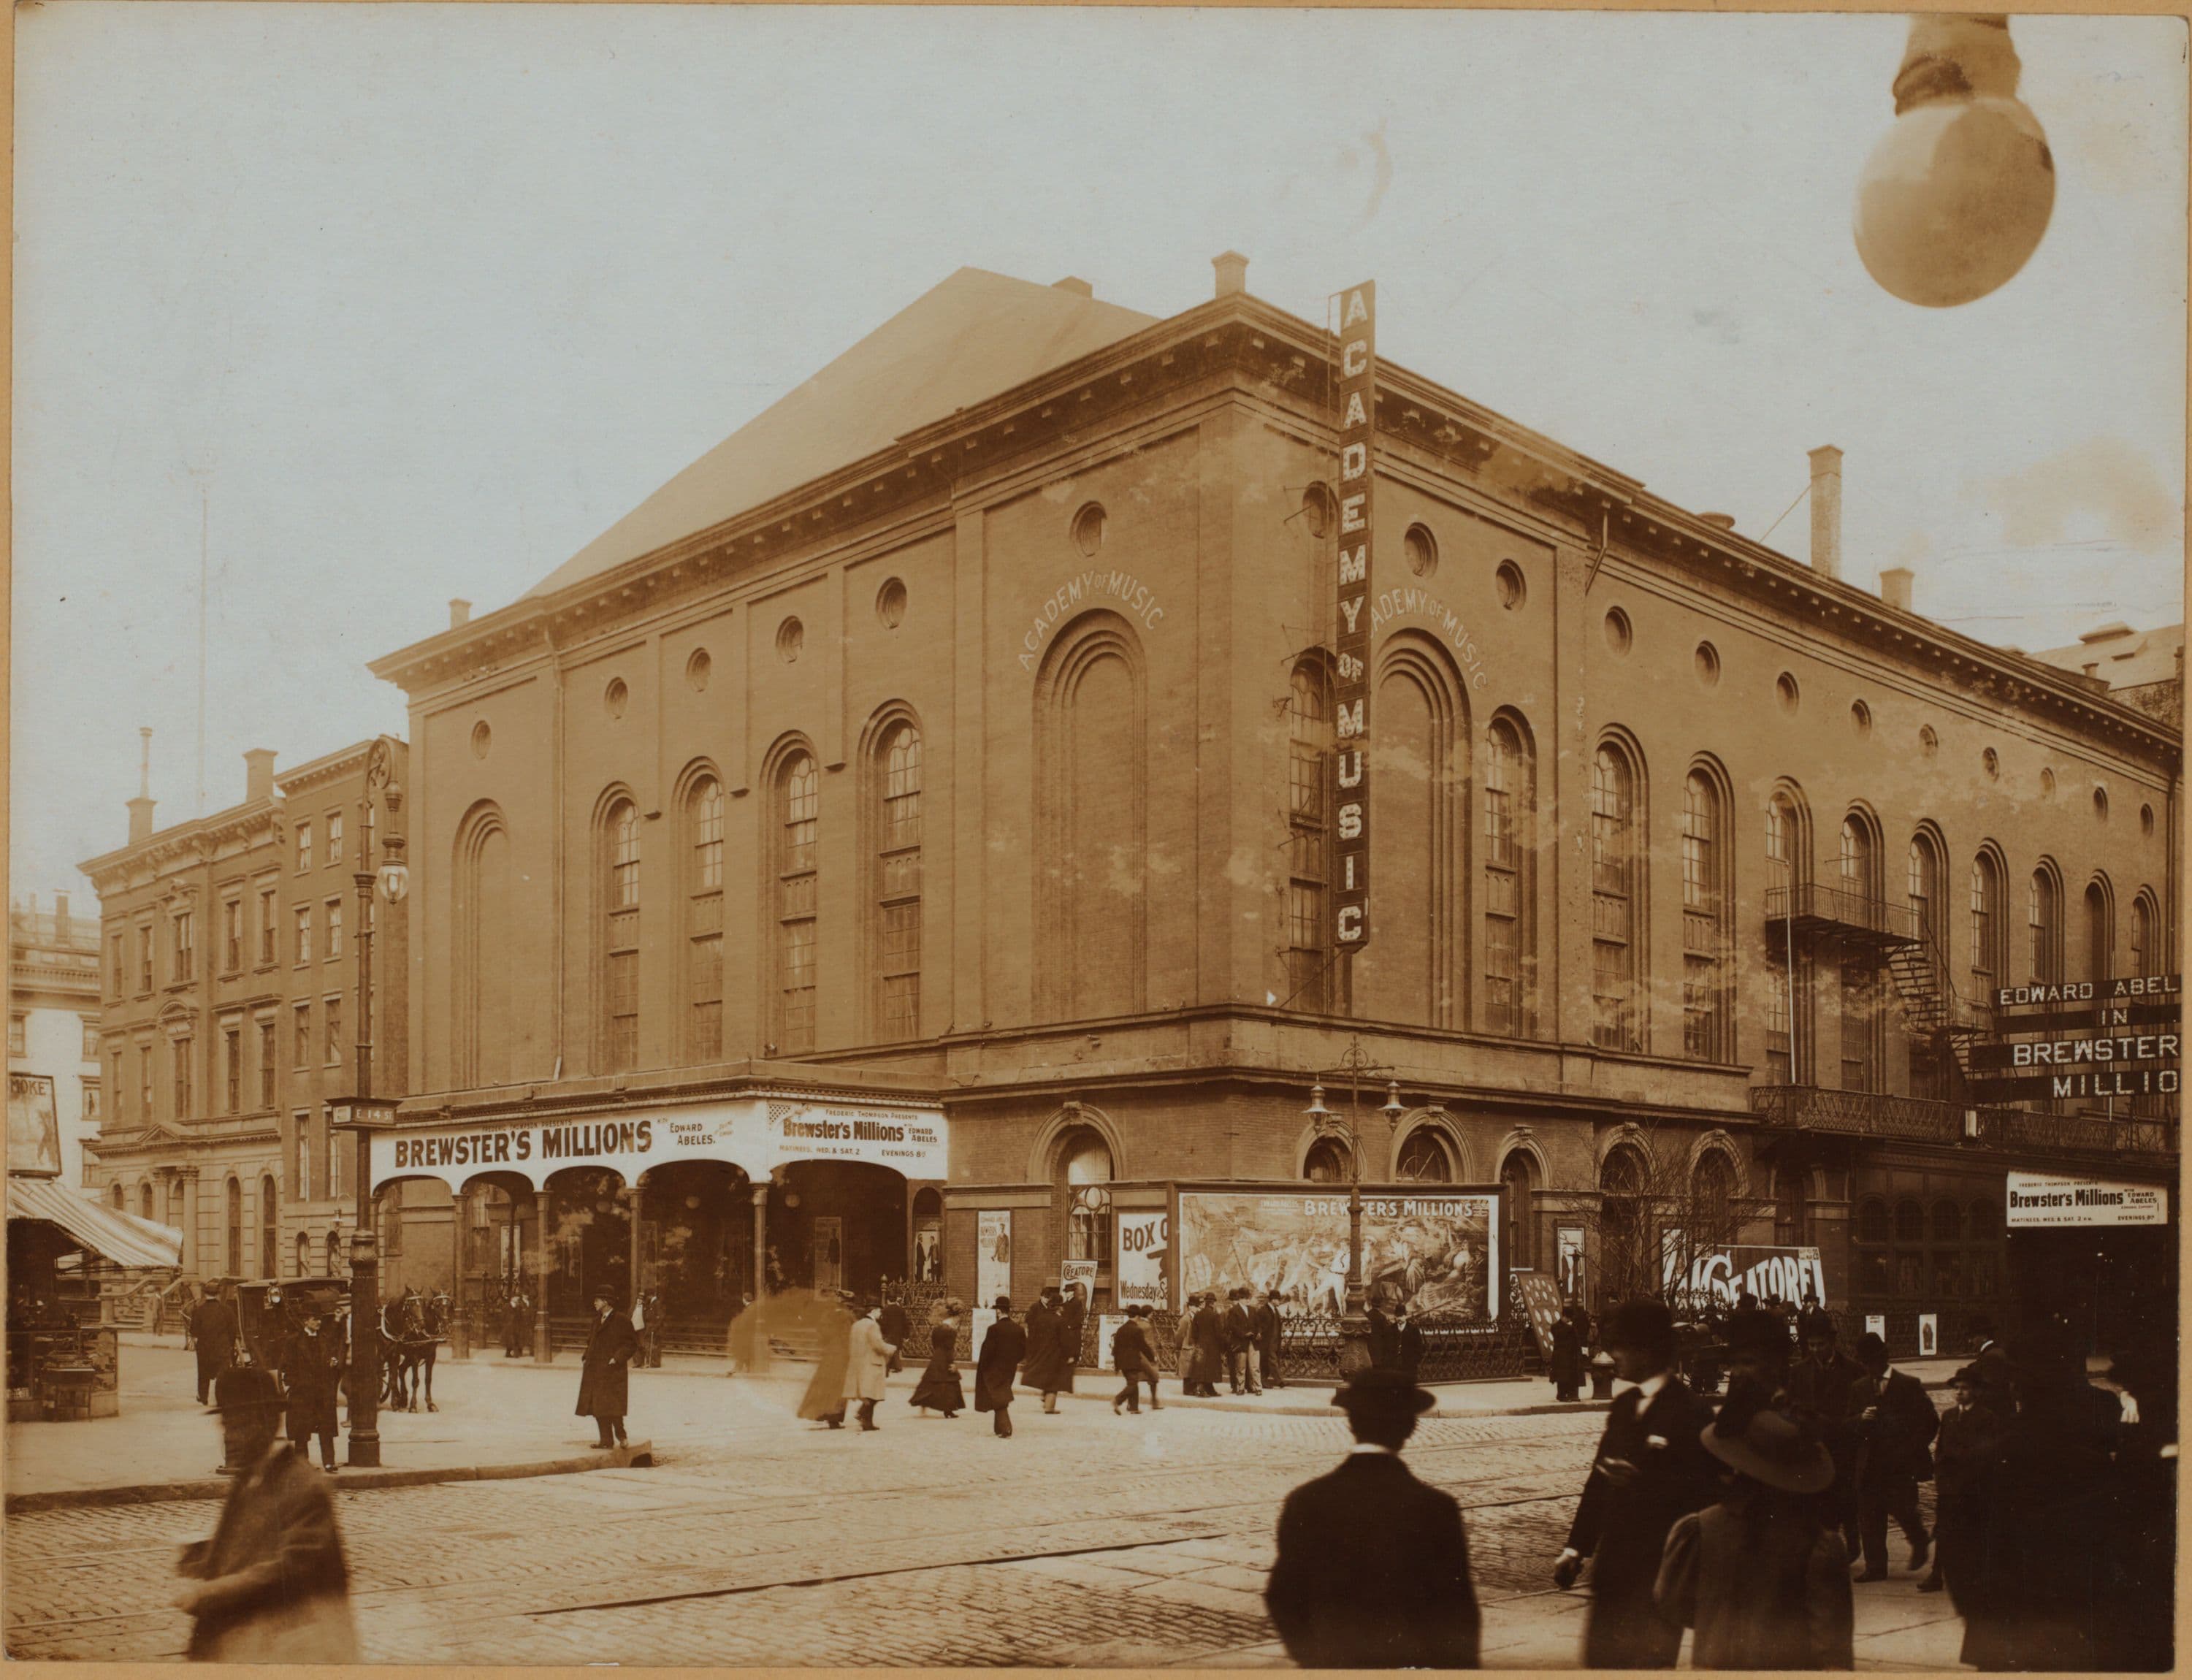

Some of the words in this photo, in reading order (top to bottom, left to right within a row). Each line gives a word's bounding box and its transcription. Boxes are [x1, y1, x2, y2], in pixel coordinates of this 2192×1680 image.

[1340, 289, 1368, 633] ACADEMY
[1018, 570, 1095, 671] ACADEMY
[1107, 570, 1164, 630] MUSIC
[1370, 587, 1428, 639] ADEMY
[1429, 599, 1444, 618] OF
[1442, 608, 1488, 690] MUSIC
[1337, 652, 1364, 681] OF
[1337, 698, 1364, 942] MUSIC
[2000, 982, 2093, 1006] EDWARD
[2114, 976, 2180, 996] ABEL
[2101, 1008, 2128, 1026] IN
[2013, 1034, 2180, 1066] BREWSTER
[2052, 1069, 2179, 1099] MILLIO
[367, 1110, 381, 1120] 14
[670, 1123, 703, 1134] EDWARD
[782, 1118, 851, 1139] Brewster's
[853, 1120, 905, 1142] Millions
[908, 1127, 933, 1135] EDWARD
[911, 1134, 939, 1143] ABELES
[394, 1129, 532, 1168] BREWSTER'S
[541, 1120, 653, 1159] MILLIONS
[832, 1146, 837, 1154] &
[881, 1149, 914, 1158] EVENINGS
[1303, 1199, 1398, 1217] BREWTER'S
[1403, 1198, 1473, 1217] MILLIONS
[2010, 1190, 2073, 1208] Brewster's
[2075, 1189, 2124, 1206] Millions
[1123, 1221, 1156, 1252] BOX
[1063, 1264, 1094, 1280] CREATORE
[1120, 1280, 1157, 1302] Wednesday
